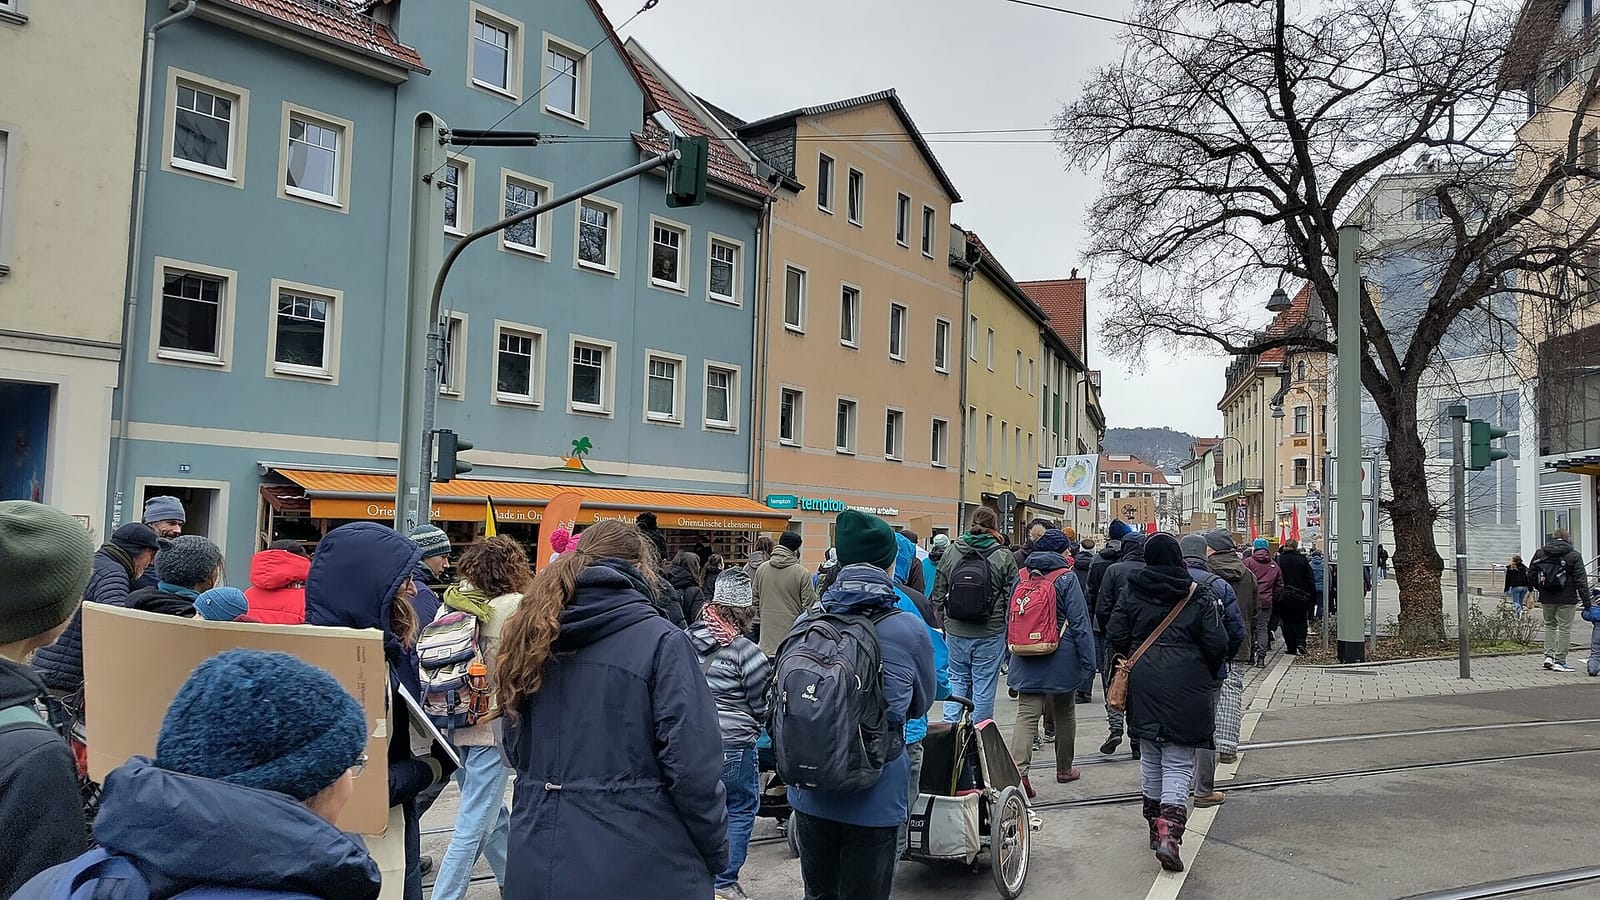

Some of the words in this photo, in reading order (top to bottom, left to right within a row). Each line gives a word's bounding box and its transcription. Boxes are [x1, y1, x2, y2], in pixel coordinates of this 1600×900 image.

[801, 496, 845, 514] tempton
[517, 510, 525, 519] in
[677, 517, 722, 528] Orientalische
[723, 519, 762, 529] Lebensmittel
